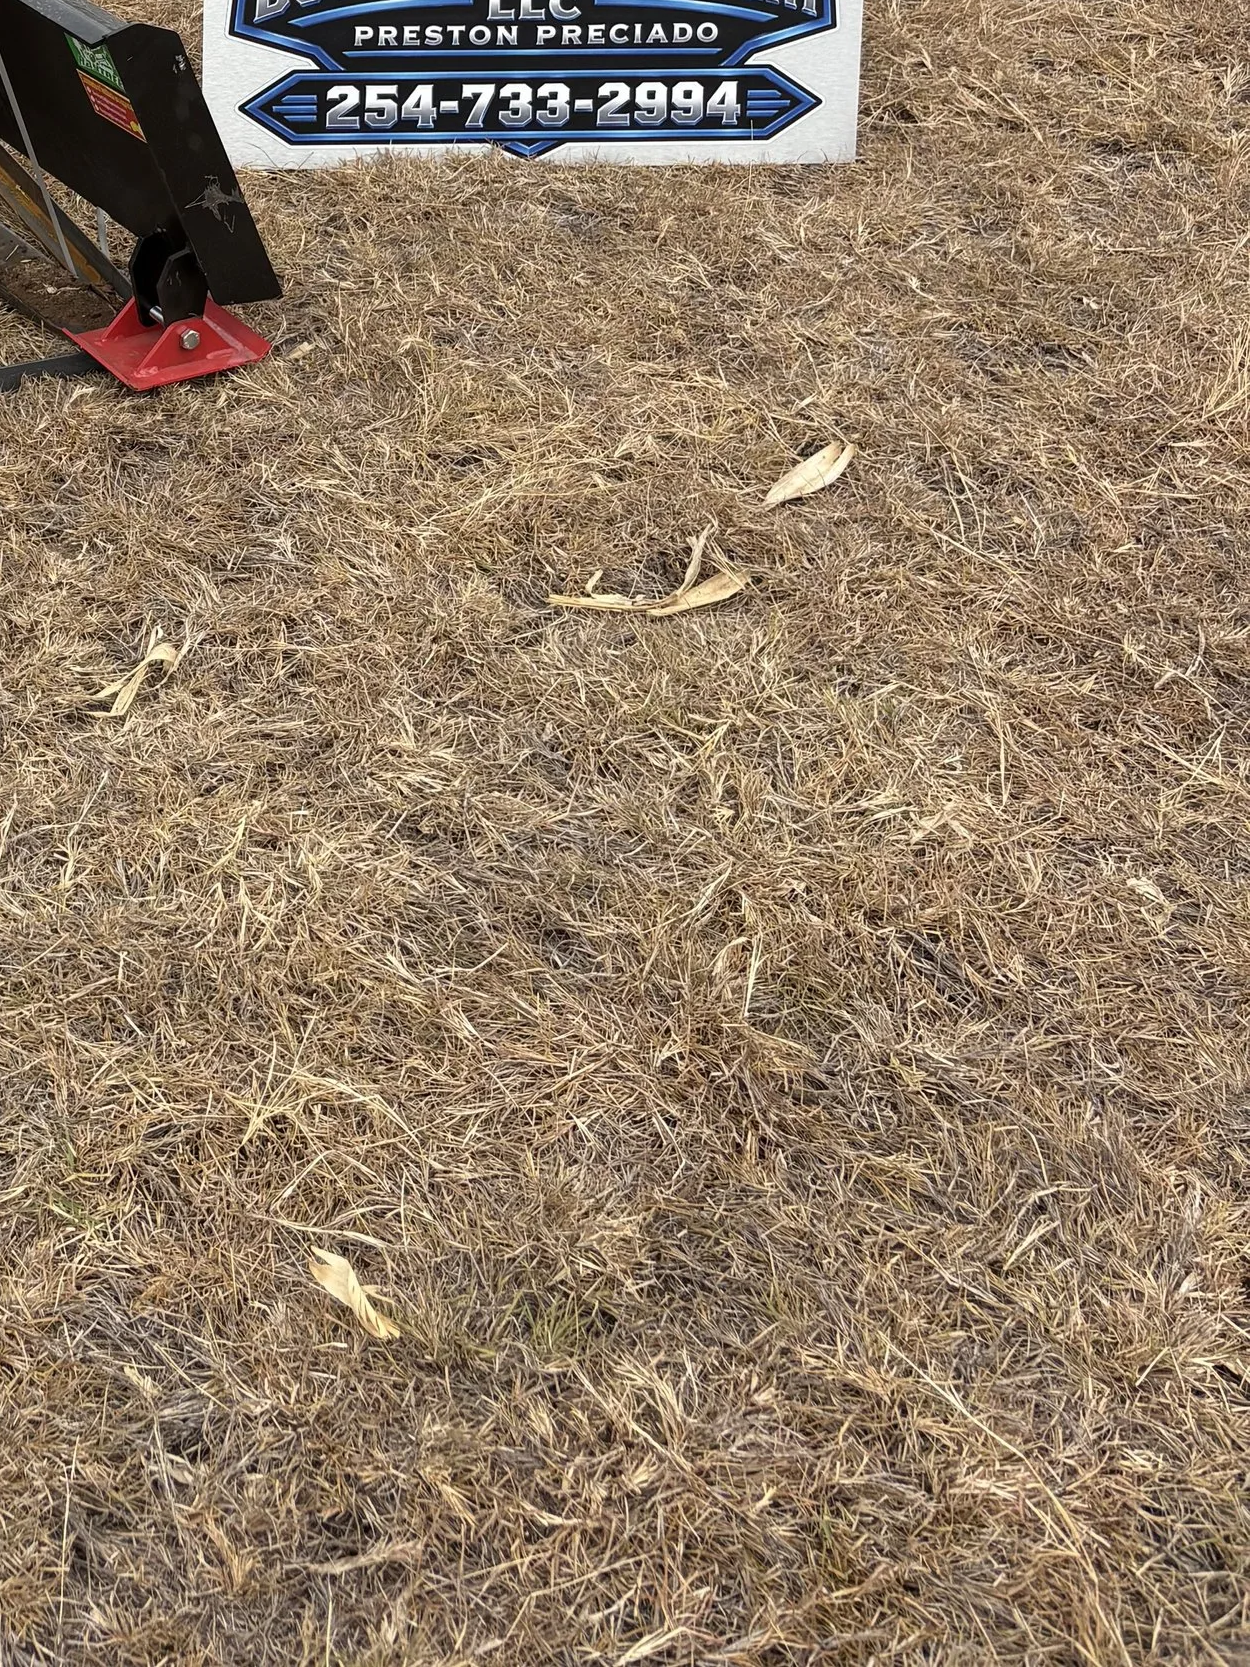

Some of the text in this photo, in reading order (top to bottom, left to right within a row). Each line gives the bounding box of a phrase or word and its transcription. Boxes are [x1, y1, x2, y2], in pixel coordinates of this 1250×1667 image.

[353, 21, 719, 47] PRESTON PRECIADO
[325, 80, 741, 130] 254-733-2994
